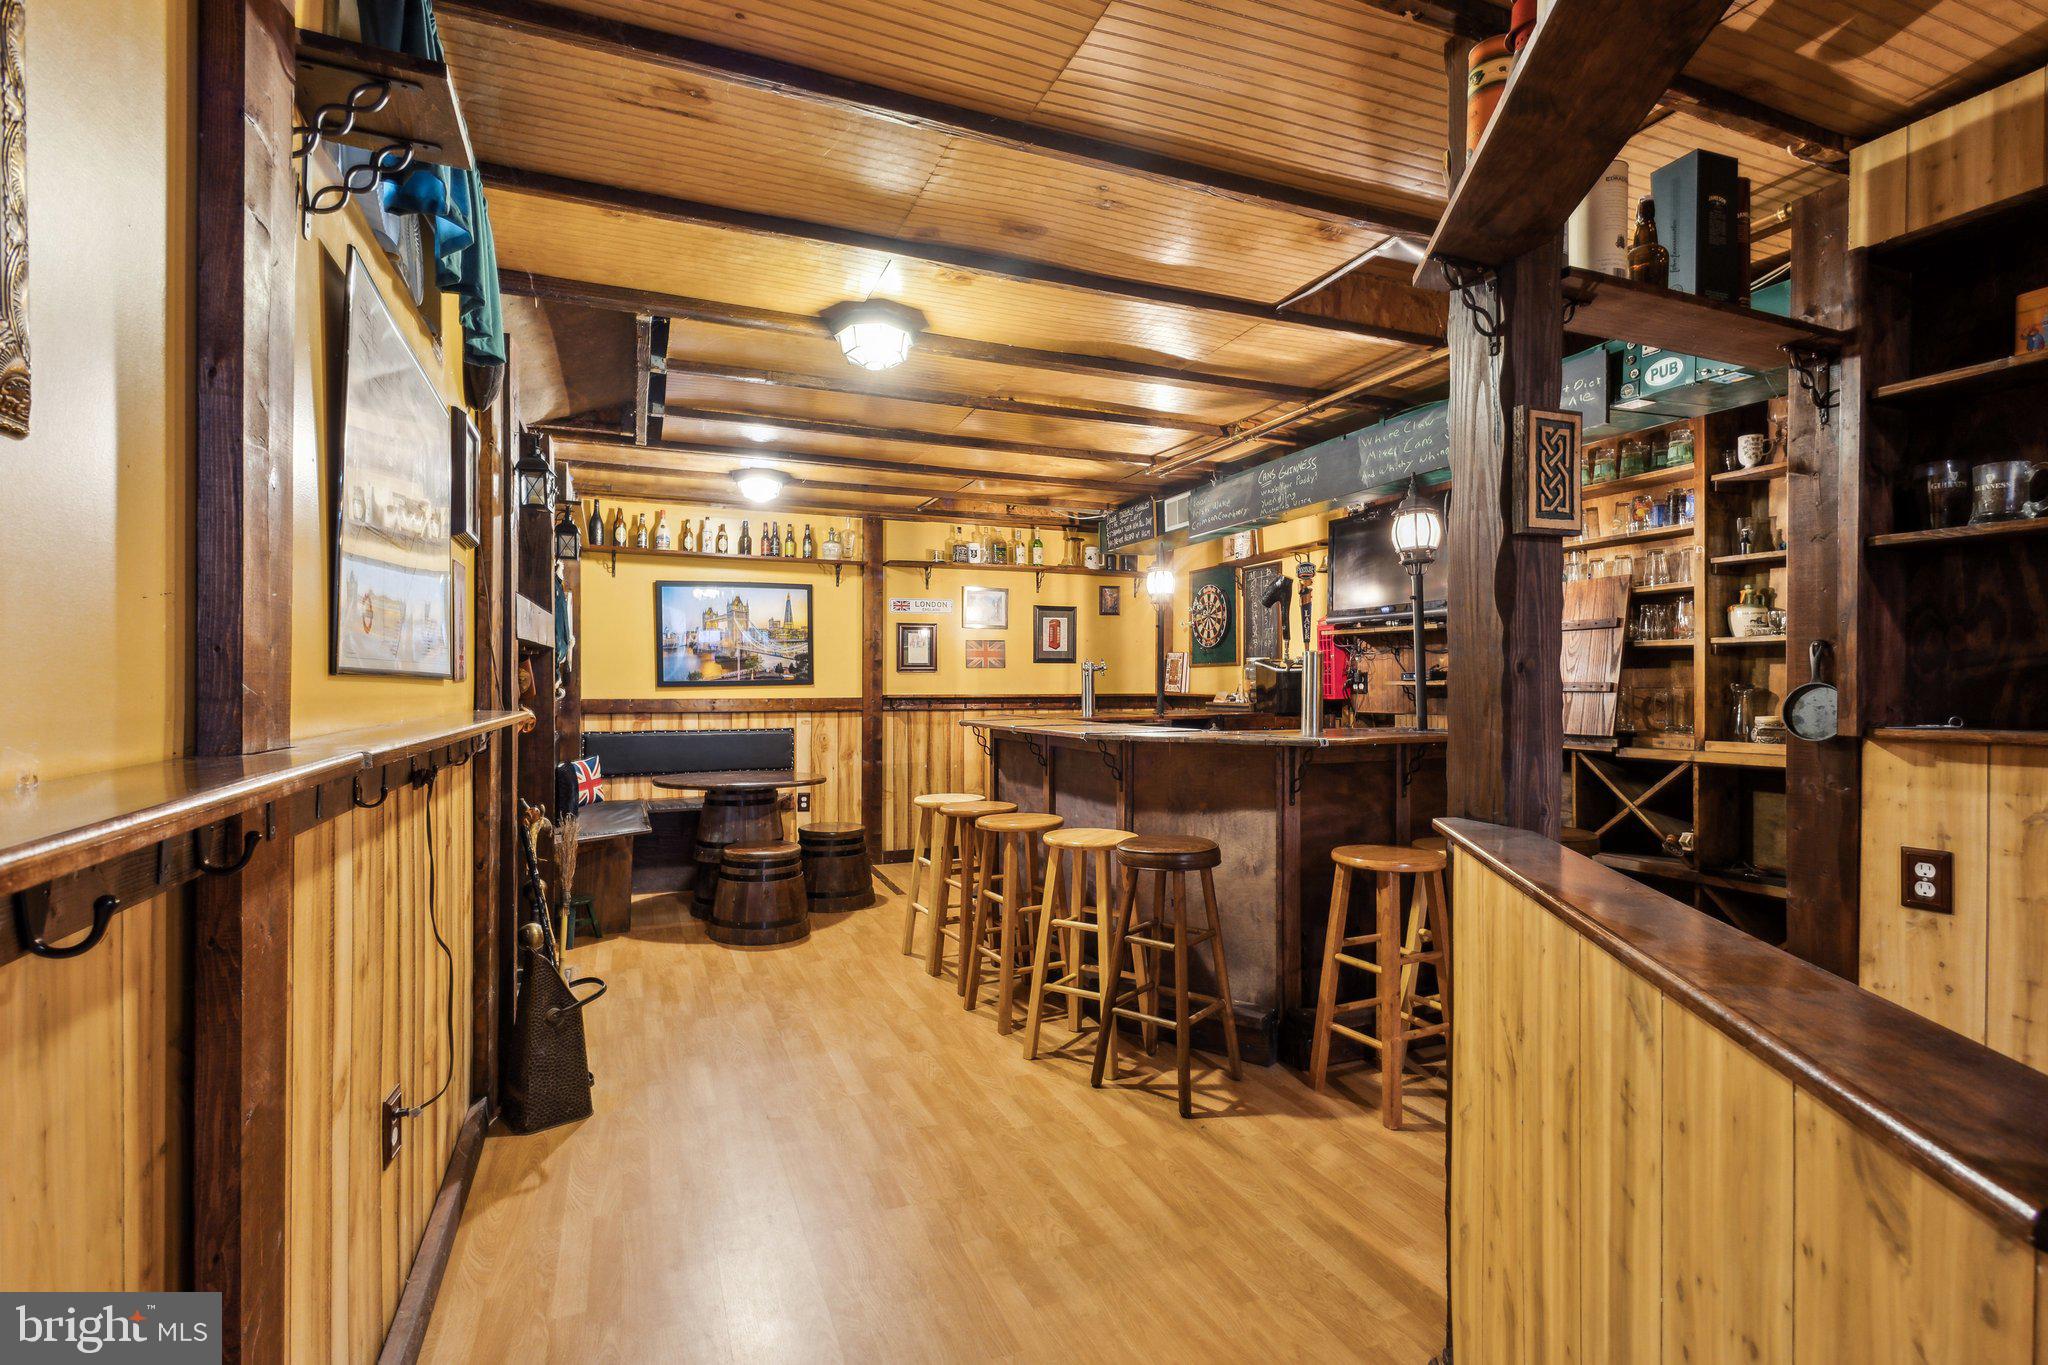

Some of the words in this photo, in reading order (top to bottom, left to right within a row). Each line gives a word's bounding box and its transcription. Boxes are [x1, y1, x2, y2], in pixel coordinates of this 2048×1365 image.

[1650, 361, 1678, 381] PUB
[1403, 418, 1435, 433] Claw
[1403, 435, 1433, 453] Cans
[1258, 468, 1276, 484] CANS
[1278, 457, 1318, 479] GUINNESS
